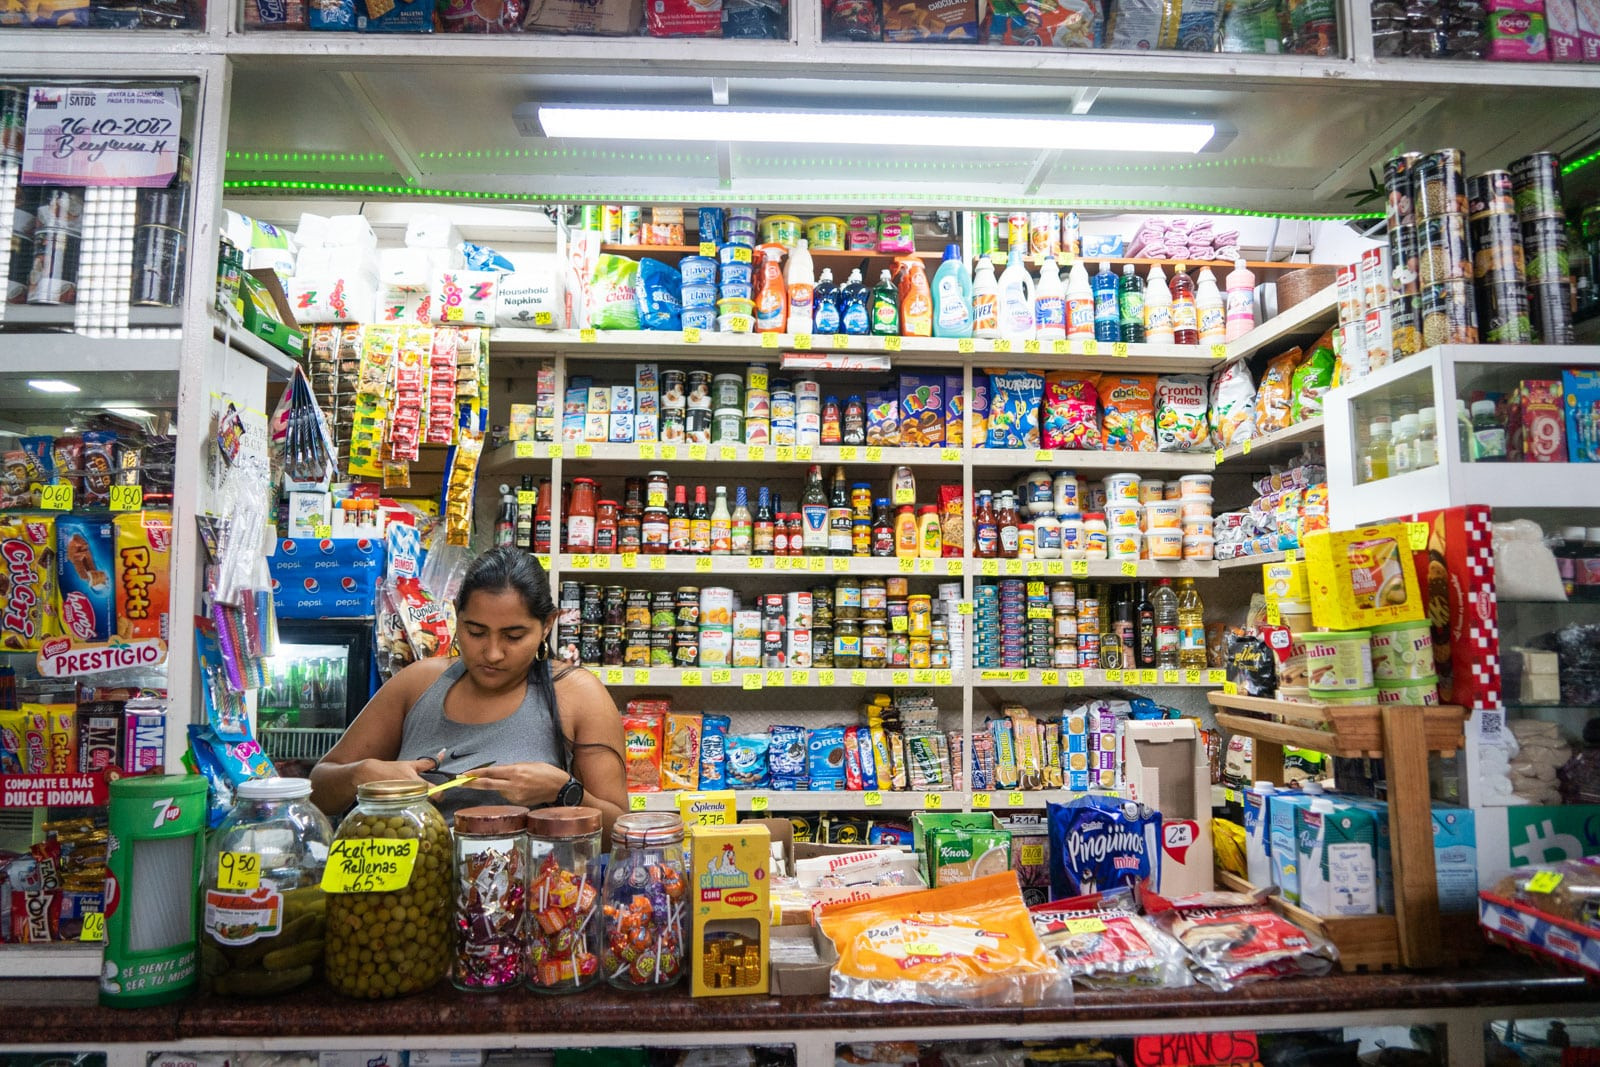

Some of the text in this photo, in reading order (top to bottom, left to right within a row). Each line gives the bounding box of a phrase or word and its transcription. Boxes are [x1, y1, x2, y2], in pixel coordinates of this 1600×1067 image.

[69, 96, 96, 107] SATDC
[499, 287, 549, 297] Household
[504, 296, 542, 307] Napkins
[1159, 385, 1203, 397] Cronch
[1167, 395, 1201, 406] Flakes
[1532, 414, 1560, 457] 9
[394, 558, 414, 571] BIMBO
[56, 645, 158, 676] PRESTIGIO
[811, 737, 845, 751] OREO
[5, 774, 94, 790] COMPARTE EL MÁS
[5, 790, 94, 806] DULCE IDIOMA
[153, 797, 180, 829] 7 up
[691, 801, 725, 813] Splenda
[330, 839, 411, 859] Aceitunas
[940, 847, 971, 858] Knorr
[340, 858, 397, 875] Rellenas
[703, 890, 720, 900] COMO
[122, 968, 135, 979] SE
[139, 960, 175, 975] SIENTE
[126, 979, 145, 991] SER
[152, 974, 164, 986] TU
[1135, 1031, 1257, 1066] GRANOS
